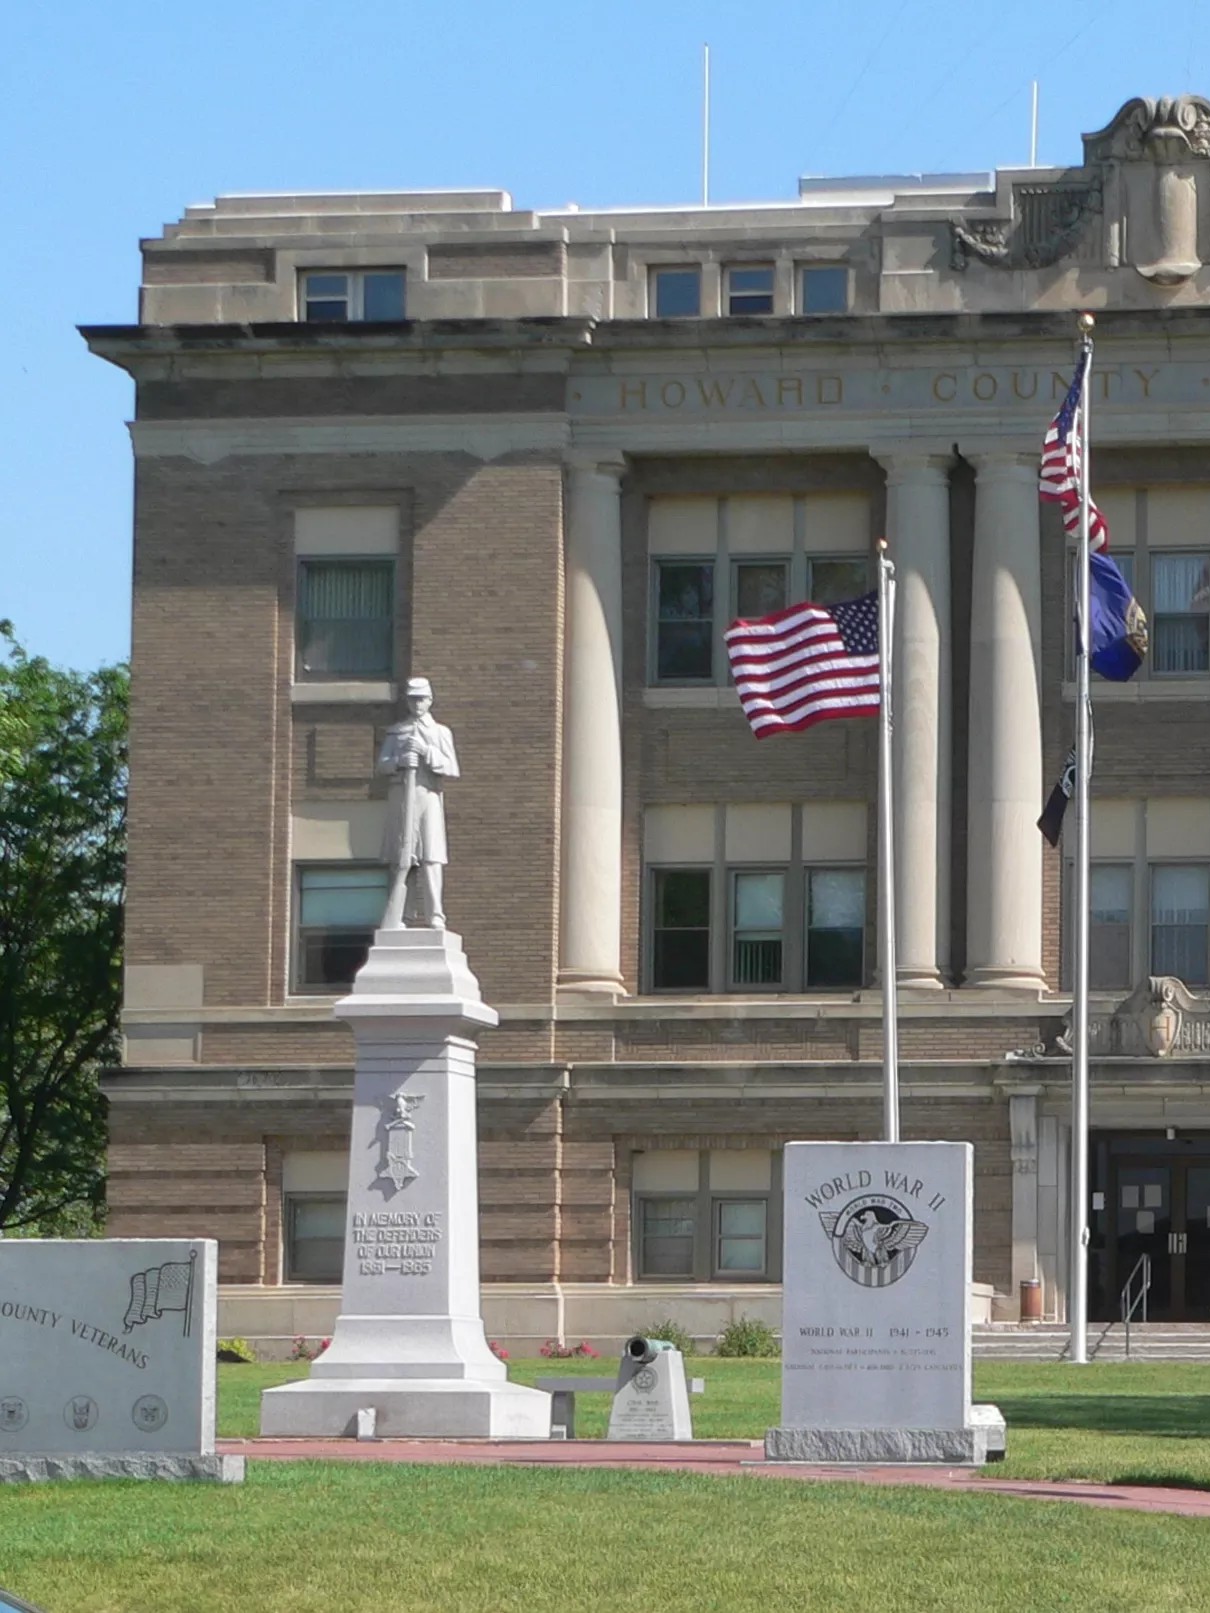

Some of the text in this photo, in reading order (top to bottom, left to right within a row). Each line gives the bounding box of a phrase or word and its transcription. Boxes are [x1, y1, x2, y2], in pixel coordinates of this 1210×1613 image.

[619, 375, 845, 410] HOWARD
[932, 368, 1161, 401] COUNTY
[804, 1169, 946, 1212] WORLD WAR II
[70, 1318, 150, 1370] VETERANS
[799, 1327, 835, 1338] WORLD
[839, 1327, 860, 1338] WAR
